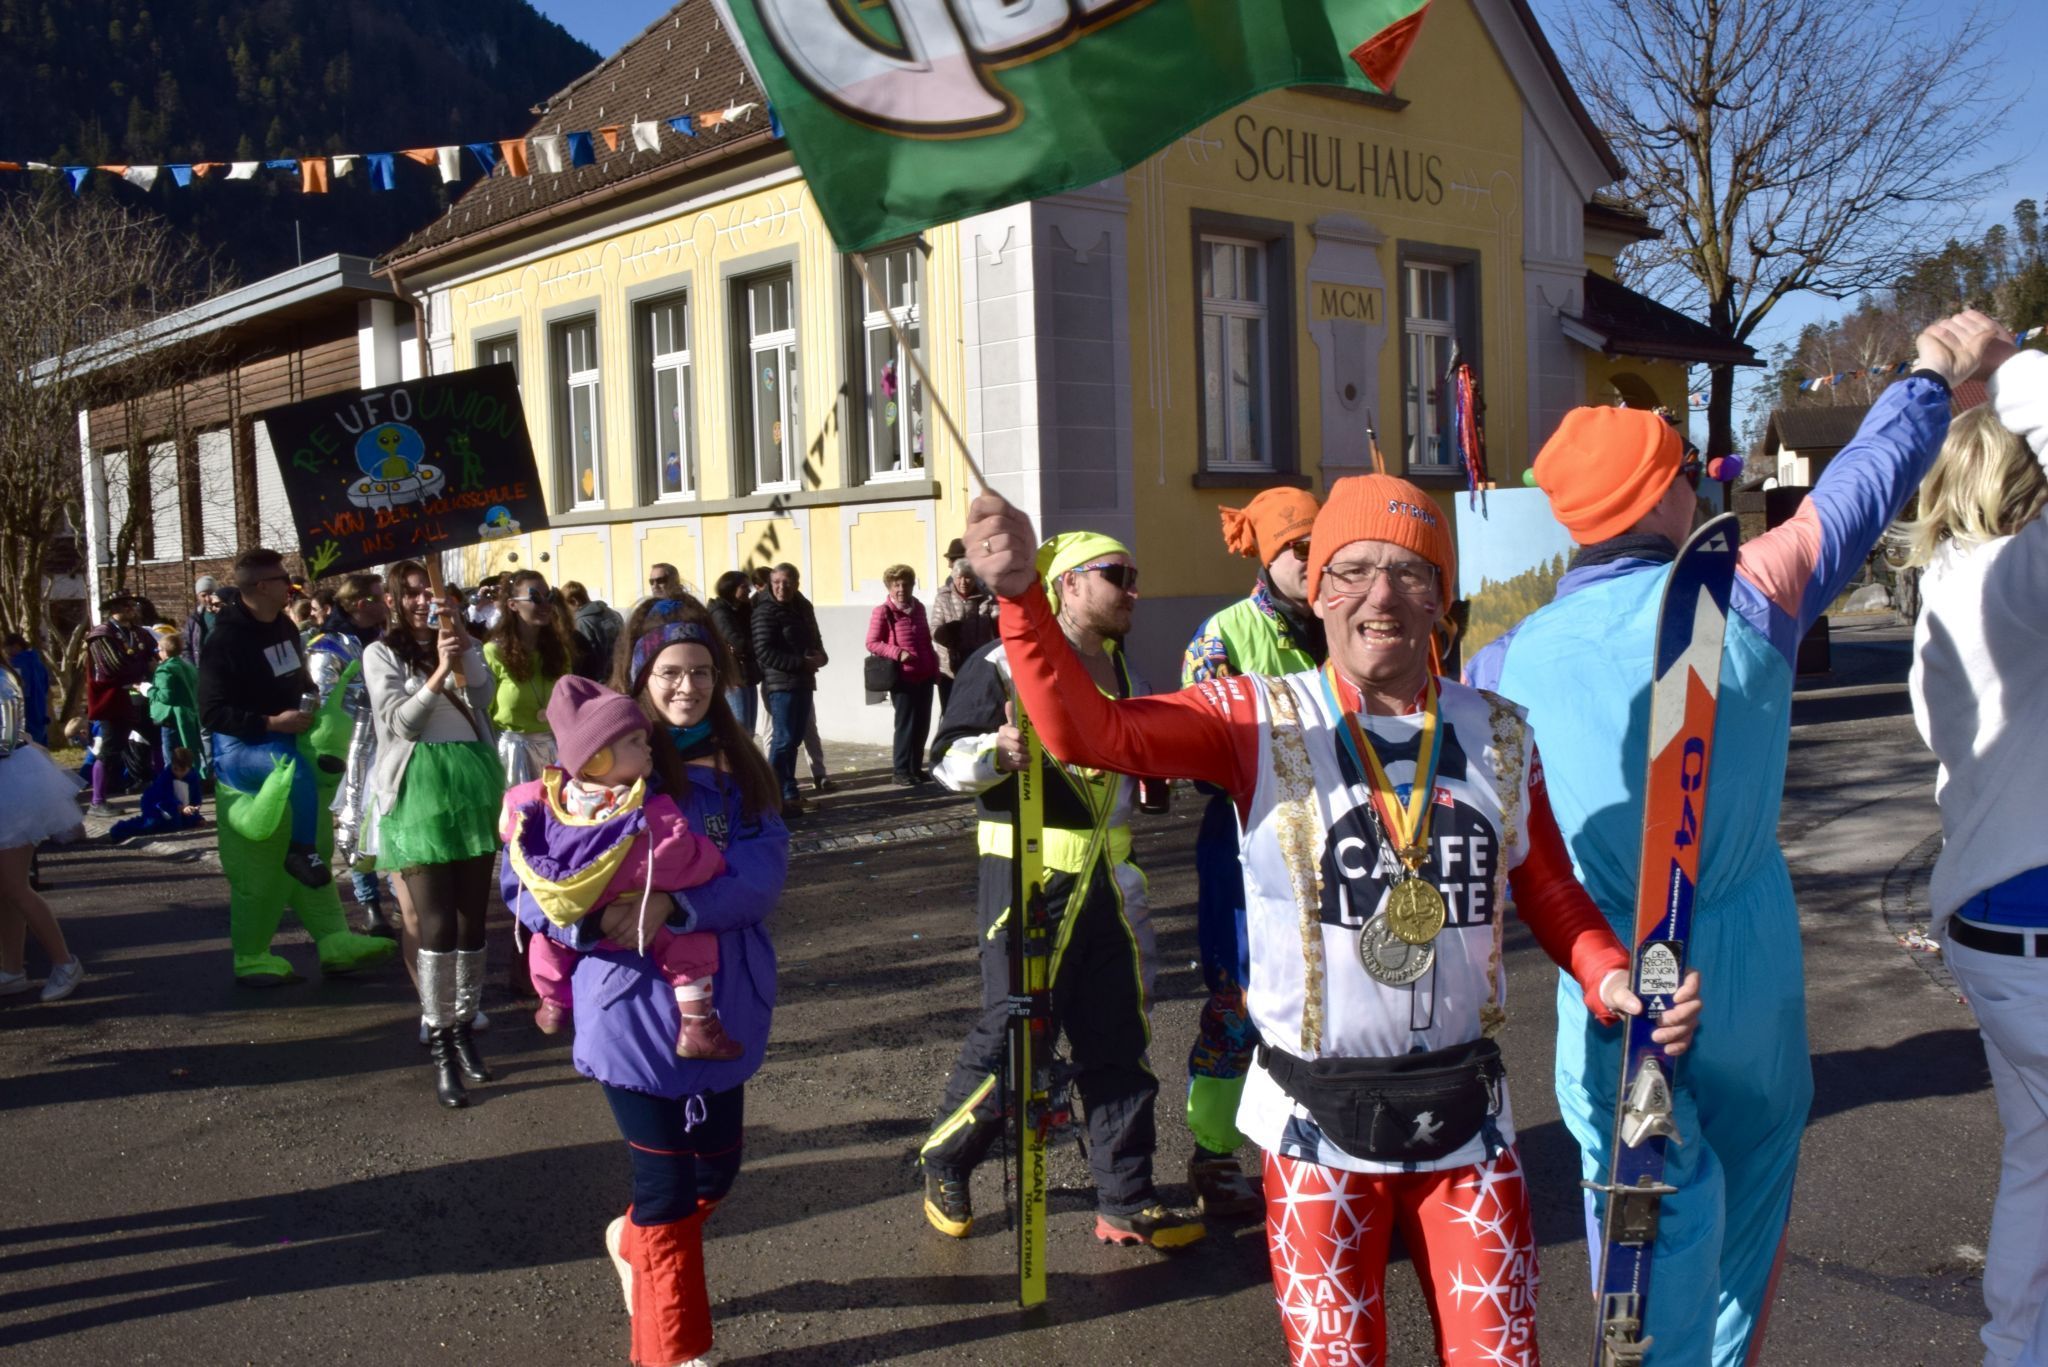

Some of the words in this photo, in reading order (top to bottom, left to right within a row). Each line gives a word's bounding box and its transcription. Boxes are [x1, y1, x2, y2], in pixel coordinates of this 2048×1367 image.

[1234, 114, 1444, 206] SCHULHAUS
[1320, 287, 1375, 321] MCM
[362, 530, 395, 556] INS
[410, 524, 449, 545] ALL
[1338, 883, 1487, 926] LTE
[1025, 1192, 1033, 1226] TOUR
[1025, 1230, 1033, 1280] EXTREM
